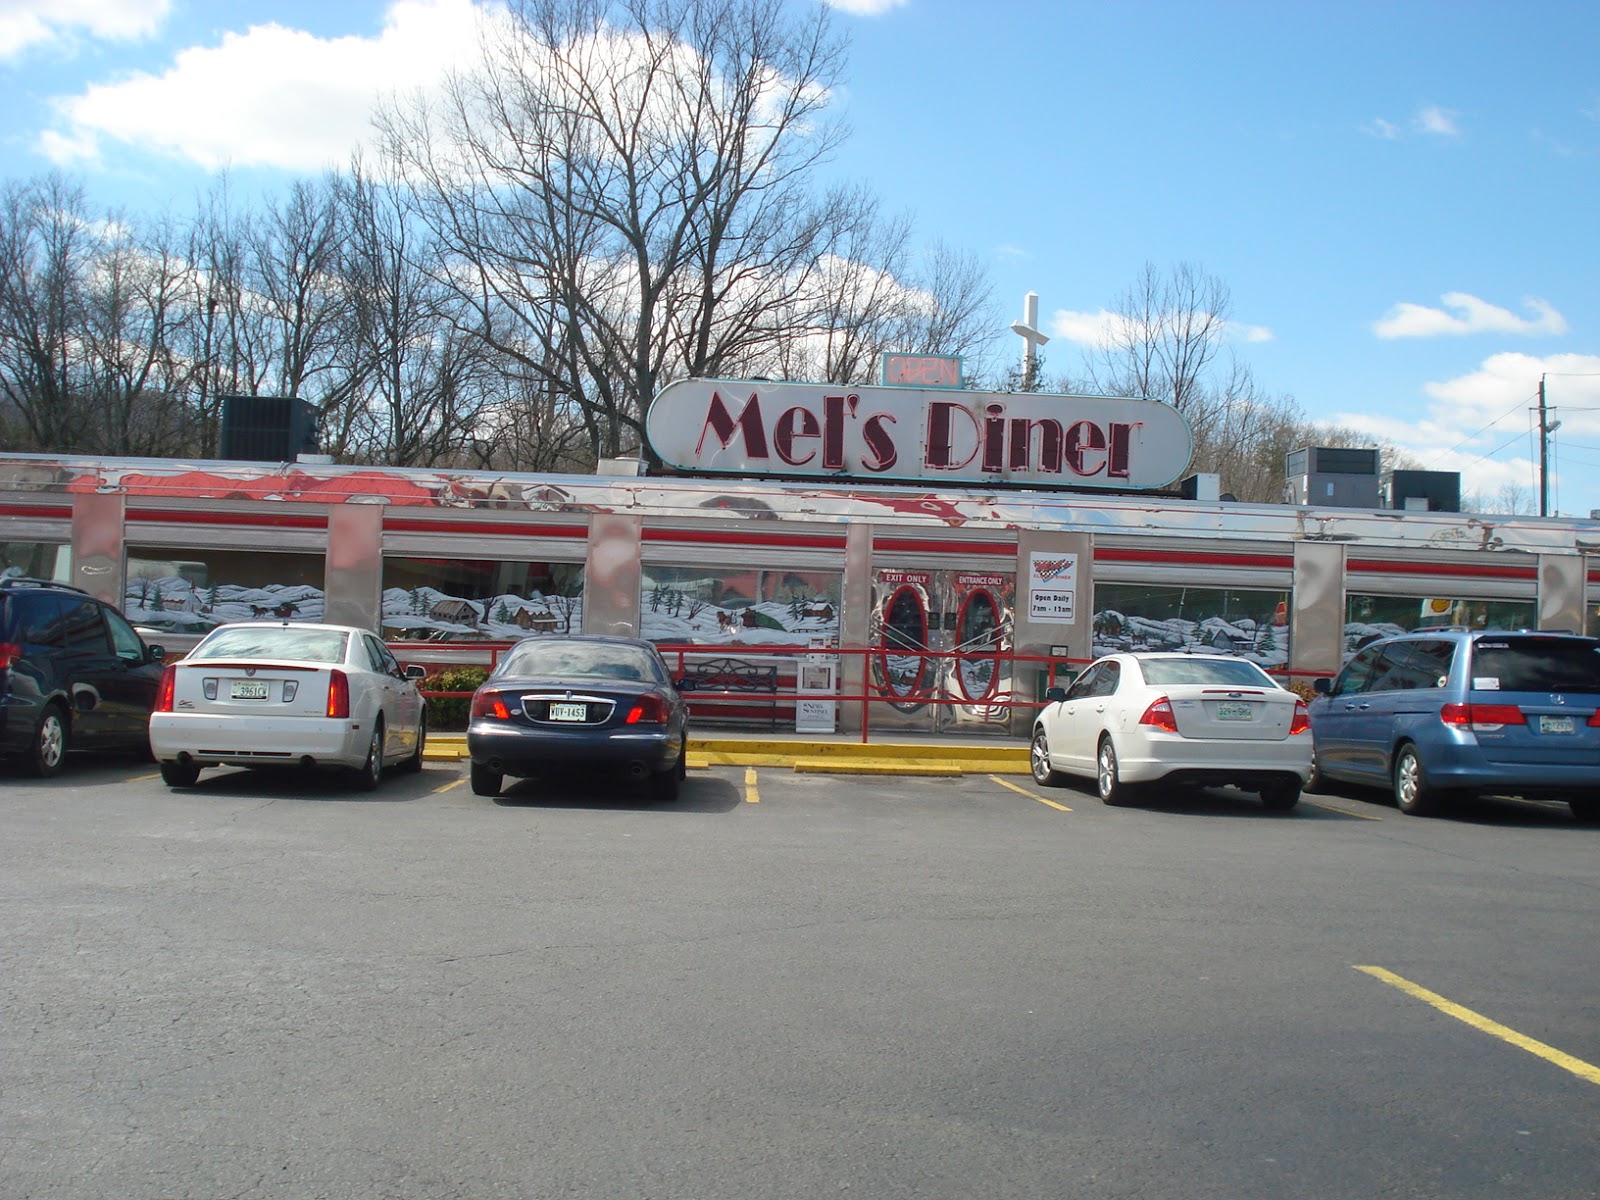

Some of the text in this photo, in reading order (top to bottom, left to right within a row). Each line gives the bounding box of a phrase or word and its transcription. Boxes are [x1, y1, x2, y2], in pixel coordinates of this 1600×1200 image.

[887, 355, 958, 386] OPEN
[694, 390, 1144, 479] Mel's Diner
[886, 573, 928, 583] EXIT ONLY
[958, 575, 1003, 585] ENTRANCE ONLY
[1034, 594, 1070, 603] Open Daily
[1032, 604, 1047, 612] 7am
[550, 706, 585, 718] WUV-1453
